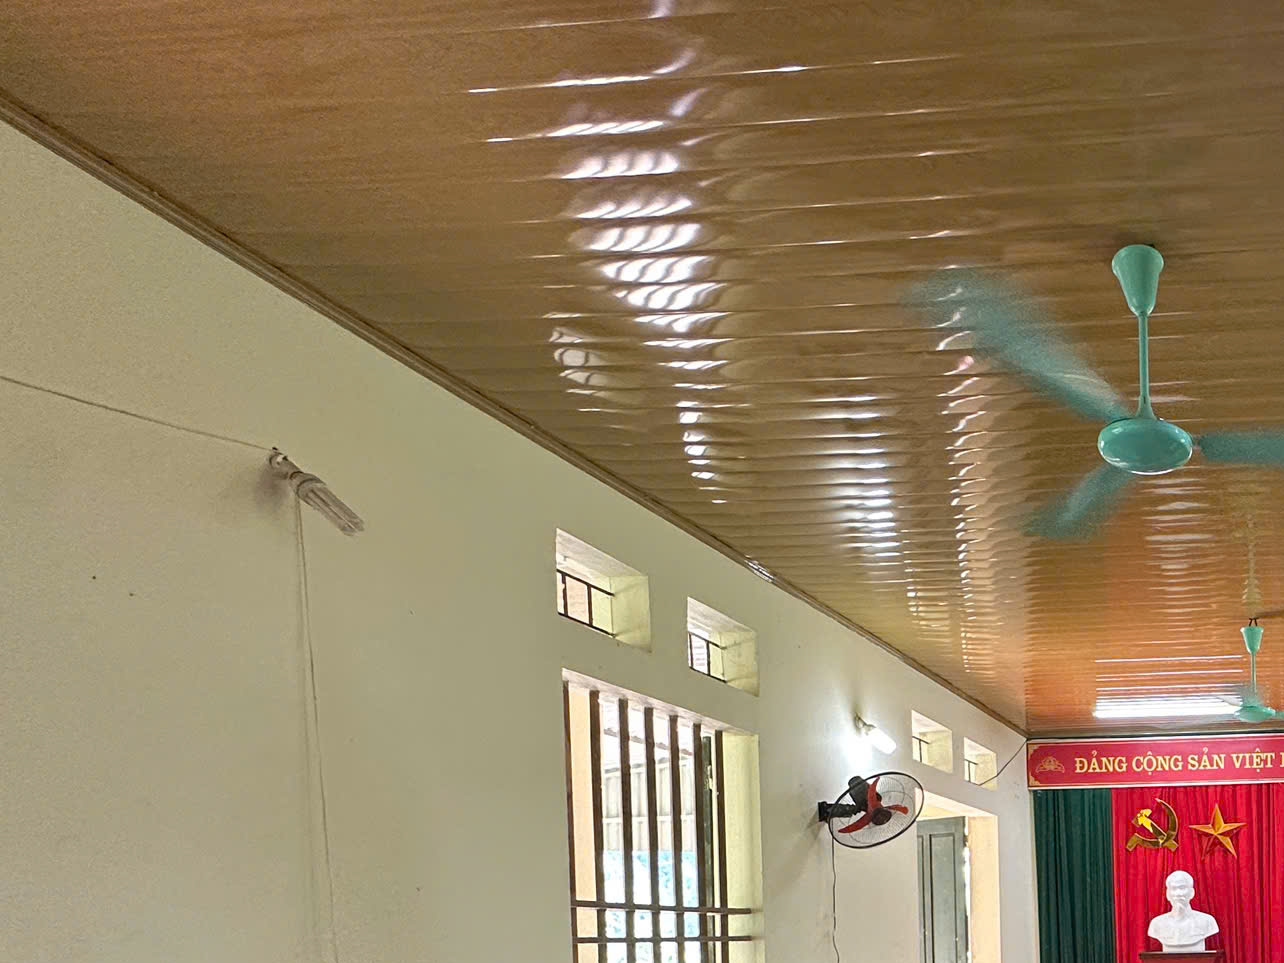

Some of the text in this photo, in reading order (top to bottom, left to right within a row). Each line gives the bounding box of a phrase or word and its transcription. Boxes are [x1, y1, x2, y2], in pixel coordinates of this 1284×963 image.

[1074, 750, 1128, 773] ĐẢNG
[1132, 751, 1183, 775] CỘNG
[1187, 747, 1226, 770] SẢN
[1231, 748, 1275, 772] VIỆT
